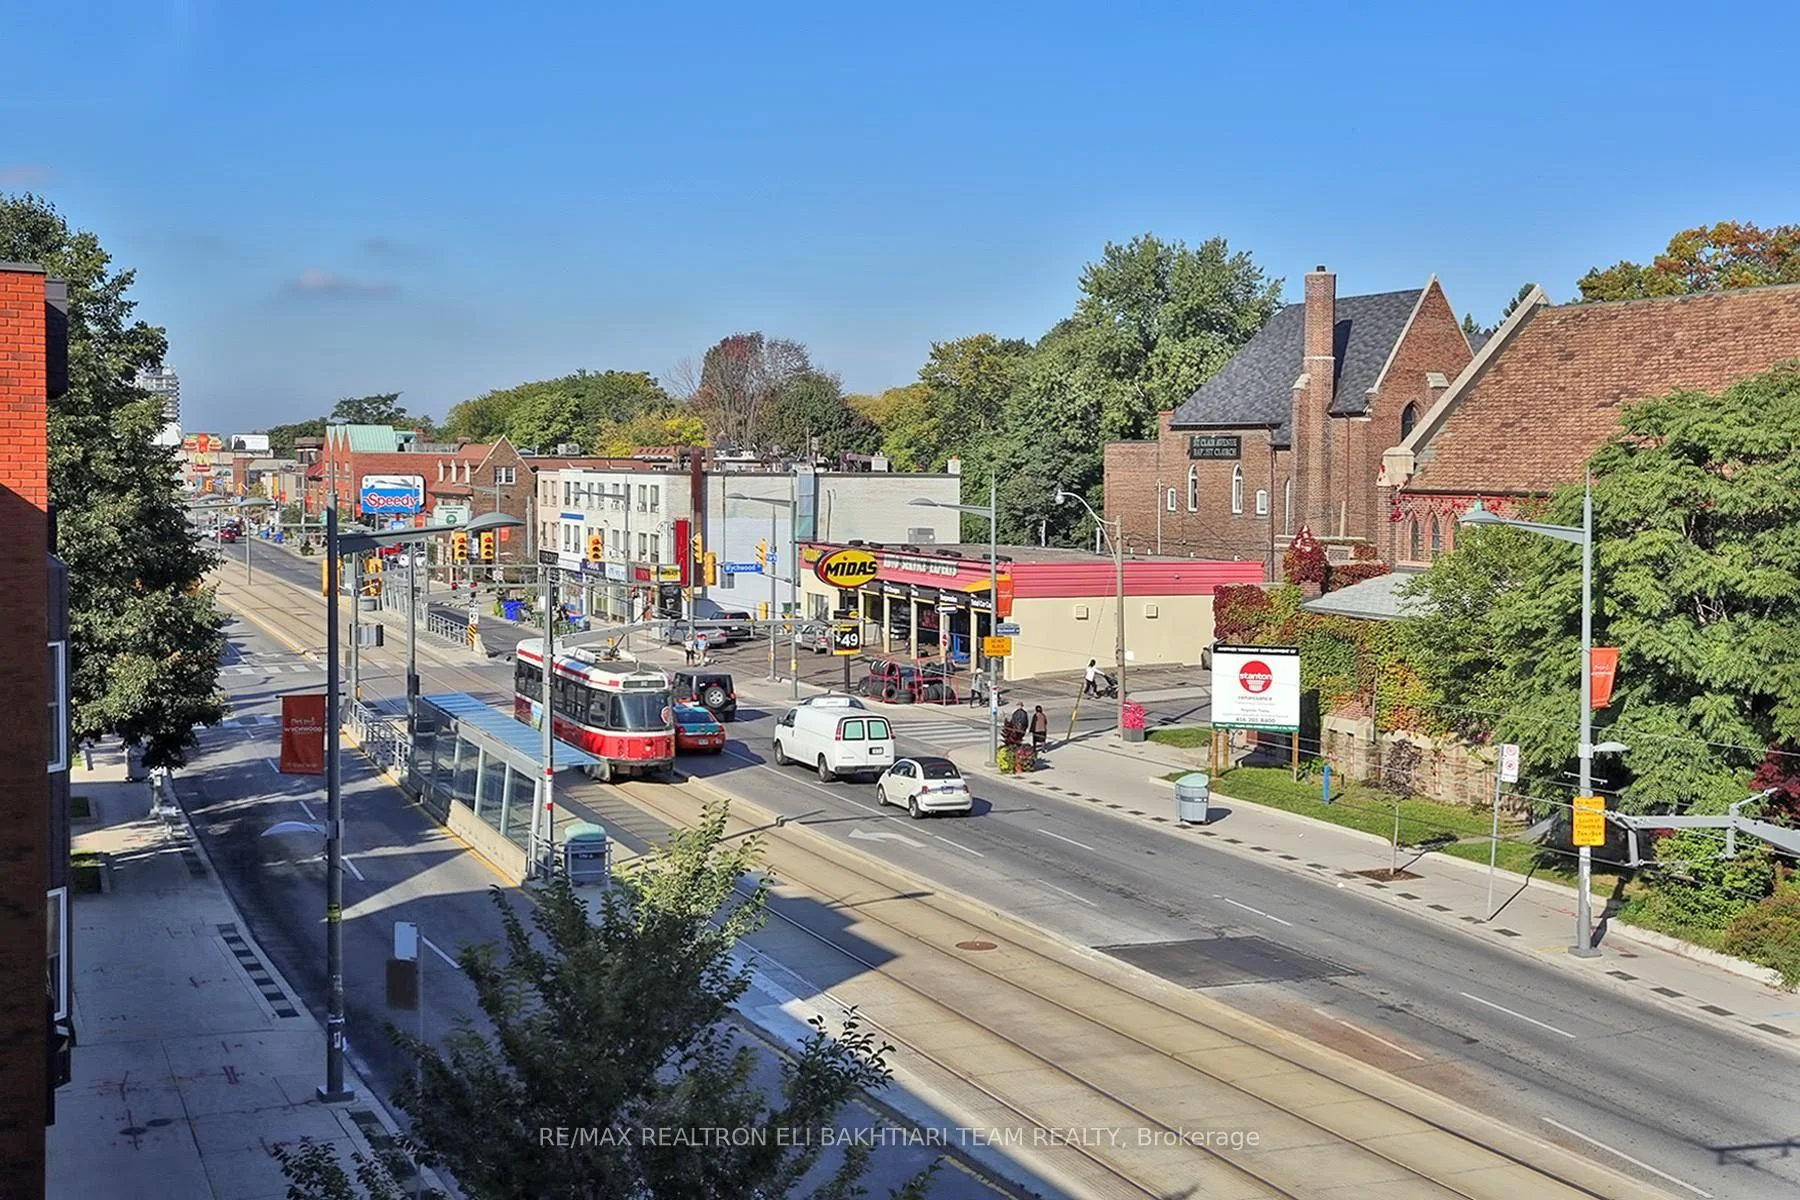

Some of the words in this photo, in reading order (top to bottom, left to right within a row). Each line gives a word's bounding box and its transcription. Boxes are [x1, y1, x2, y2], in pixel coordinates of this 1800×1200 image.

[1216, 438, 1237, 447] AVENUE
[1193, 447, 1214, 457] BAPTIST
[1214, 447, 1237, 457] CHURCH
[366, 492, 418, 508] Speedy
[725, 564, 757, 573] Wychwood
[826, 557, 878, 577] MIDAS
[1239, 672, 1273, 680] stanton
